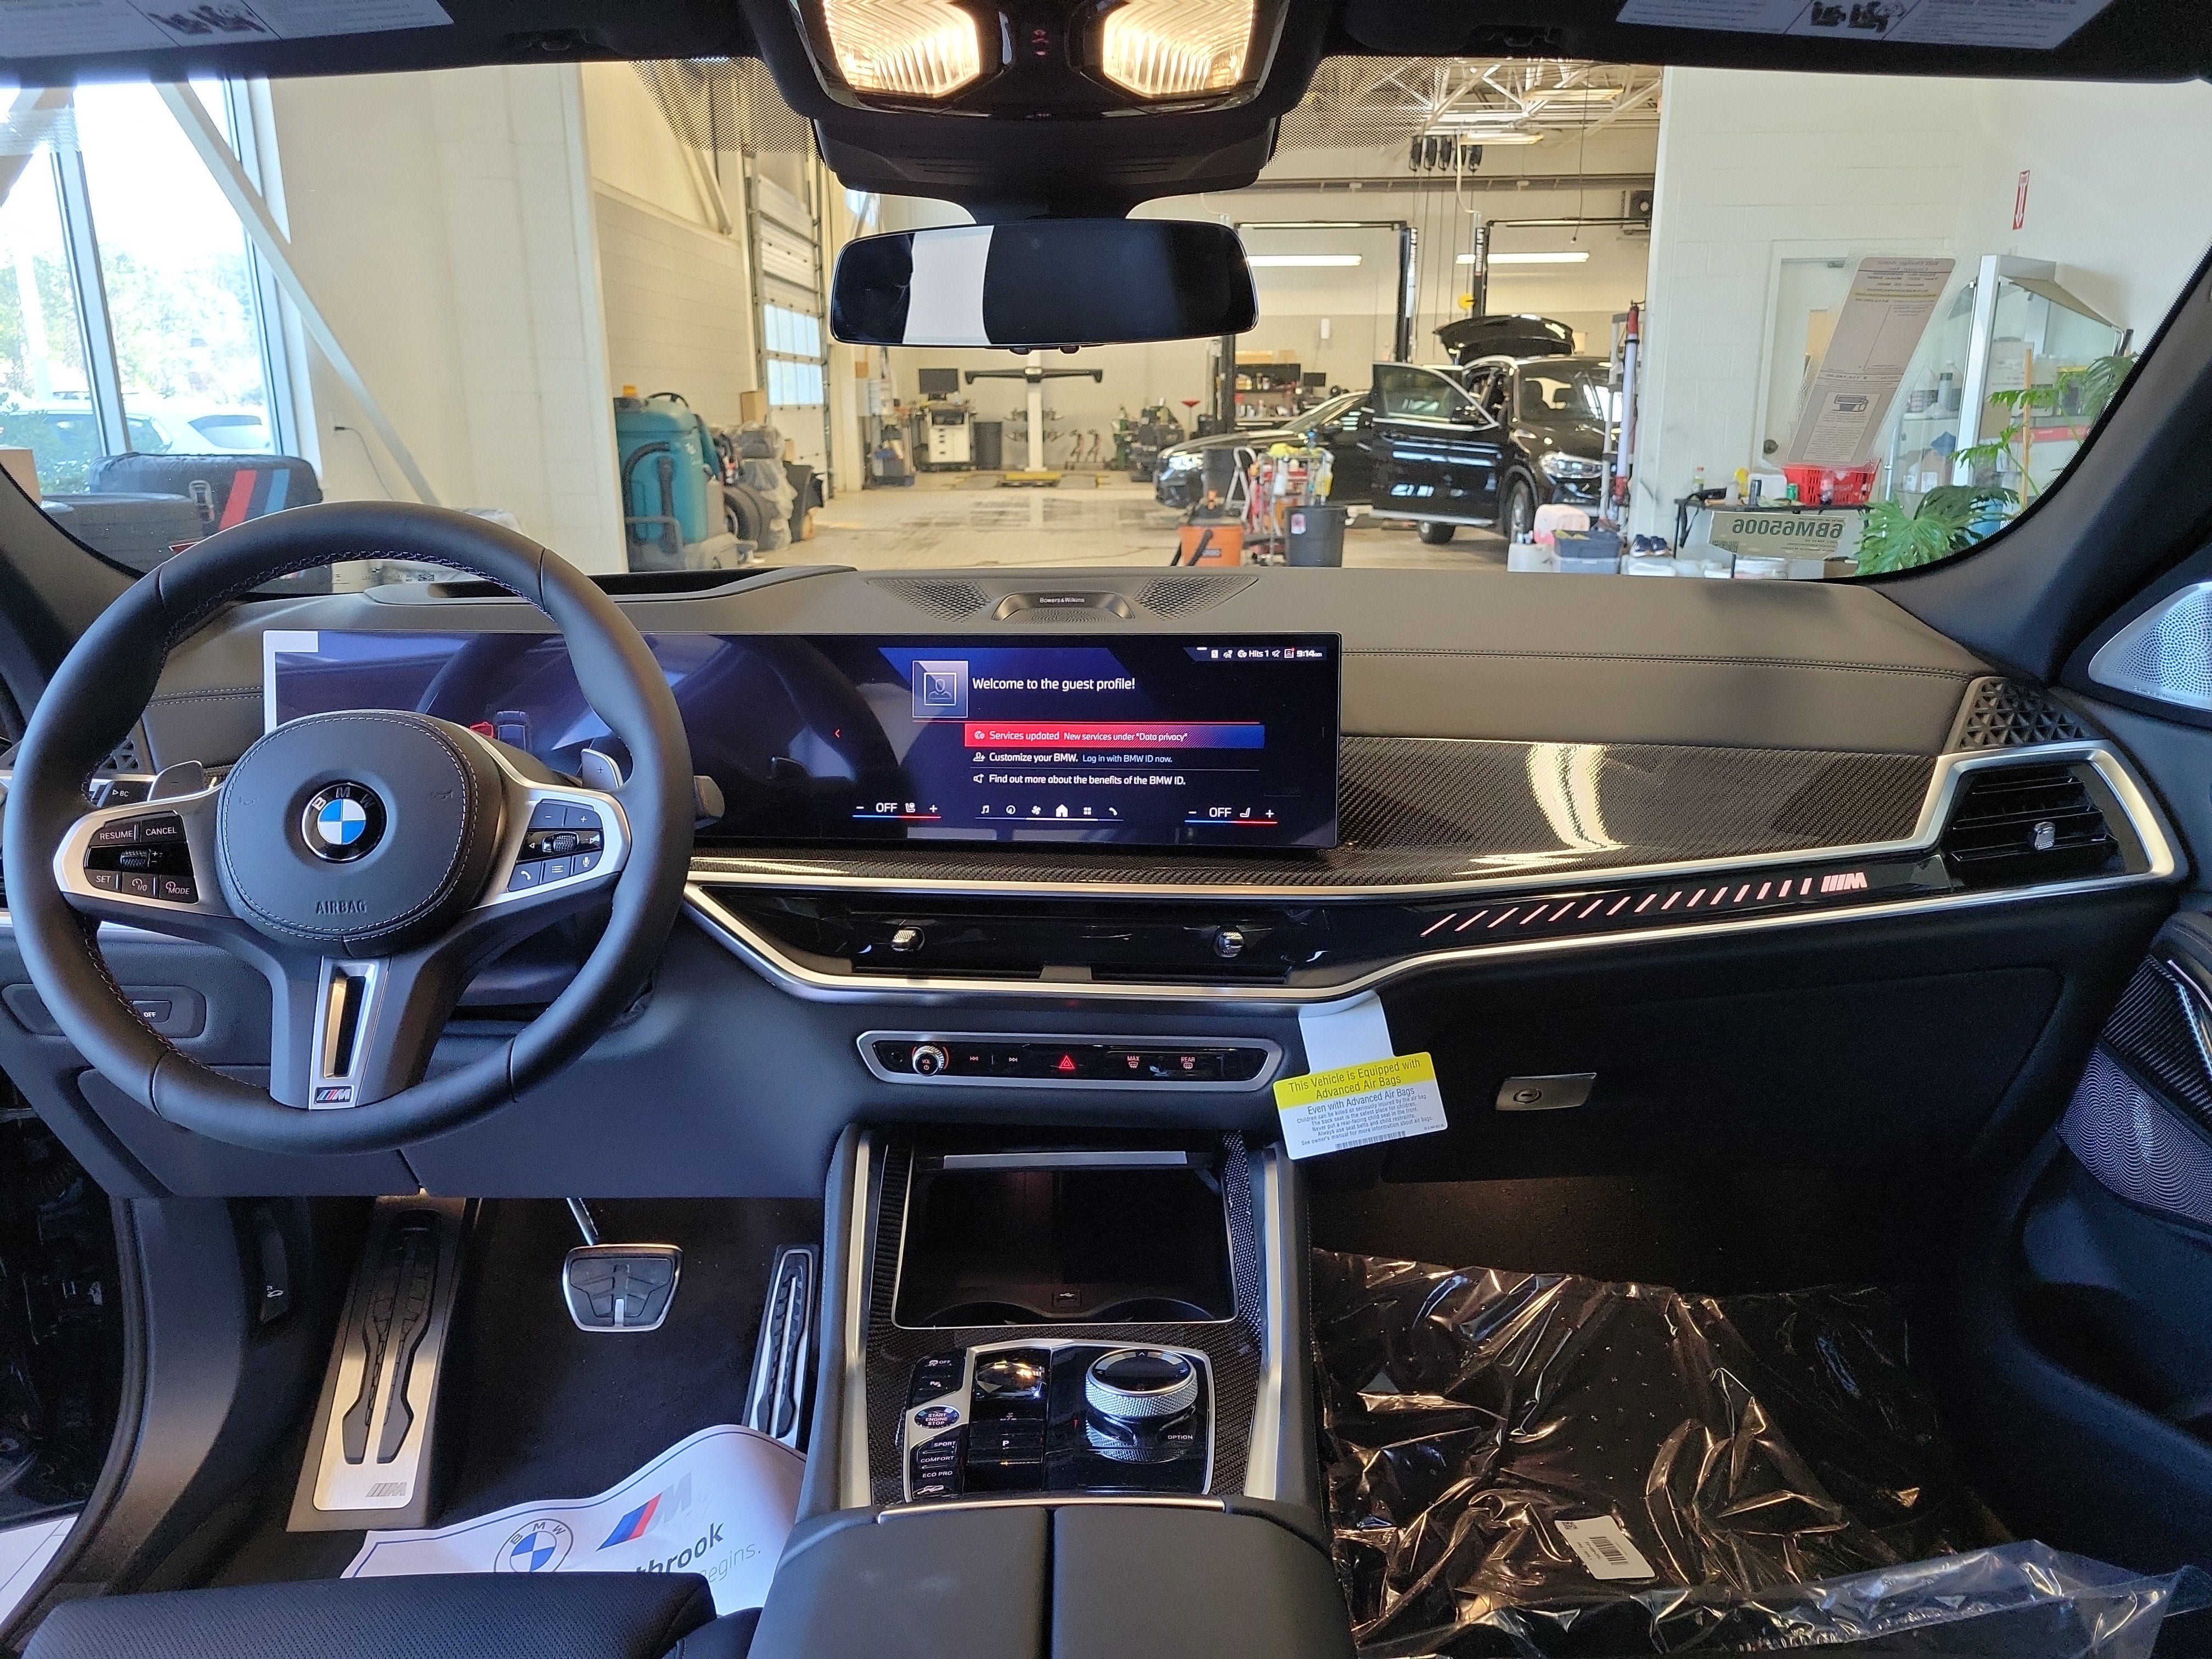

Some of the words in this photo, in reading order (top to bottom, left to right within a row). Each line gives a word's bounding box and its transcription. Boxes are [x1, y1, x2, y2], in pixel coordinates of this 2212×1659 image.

[972, 678, 1024, 690] Welcome
[1026, 679, 1038, 690] to
[1041, 678, 1059, 689] the
[1062, 679, 1094, 691] guest
[1097, 678, 1135, 691] profile!
[989, 731, 1024, 740] Services
[1026, 731, 1059, 741] updated
[1113, 732, 1134, 741] under
[1136, 732, 1156, 741] "Data
[1158, 732, 1188, 742] privacy"
[989, 753, 1032, 762] Customize
[1034, 755, 1052, 763] your
[1053, 754, 1078, 762] BMW.
[1082, 755, 1097, 764] Log
[1107, 754, 1122, 763] with
[989, 774, 1008, 783] Find
[1047, 775, 1072, 784] about
[1074, 775, 1087, 784] the
[1088, 775, 1122, 785] benefits
[1124, 775, 1133, 785] of
[1133, 776, 1148, 785] the
[1149, 776, 1172, 785] BMW
[1174, 776, 1186, 785] ID.
[312, 787, 375, 811] BMW
[876, 803, 898, 813] OFF
[1209, 806, 1232, 819] OFF
[100, 830, 133, 840] RESUME
[145, 827, 177, 836] CANCEL
[317, 900, 367, 915] AIRBAG
[1288, 1081, 1309, 1093] This
[1311, 1073, 1345, 1087] Vehicle
[1347, 1070, 1355, 1080] is
[1358, 1062, 1400, 1079] Equipped
[1402, 1058, 1420, 1070] with
[1316, 1084, 1361, 1099] Advanced
[1363, 1079, 1376, 1090] Air
[1379, 1074, 1402, 1088] Bags
[1307, 1103, 1327, 1115] Even
[1329, 1101, 1344, 1110] with
[1346, 1093, 1383, 1107] Advanced
[1385, 1090, 1395, 1099] Air
[1396, 1087, 1415, 1098] Bags
[1296, 1115, 1317, 1124] Children
[1356, 1104, 1378, 1112] seriously
[1378, 1099, 1395, 1108] injured
[1375, 1107, 1388, 1115] place
[1397, 1102, 1417, 1110] children.
[1341, 1117, 1367, 1126] rear-facing
[1392, 1114, 1415, 1122] restraints.
[1311, 1135, 1330, 1144] owner's
[1331, 1132, 1349, 1141] manual
[1372, 1122, 1399, 1131] information
[920, 1455, 955, 1463] COMFORT
[510, 1522, 566, 1545] BMW
[700, 1544, 761, 1583] egins.
